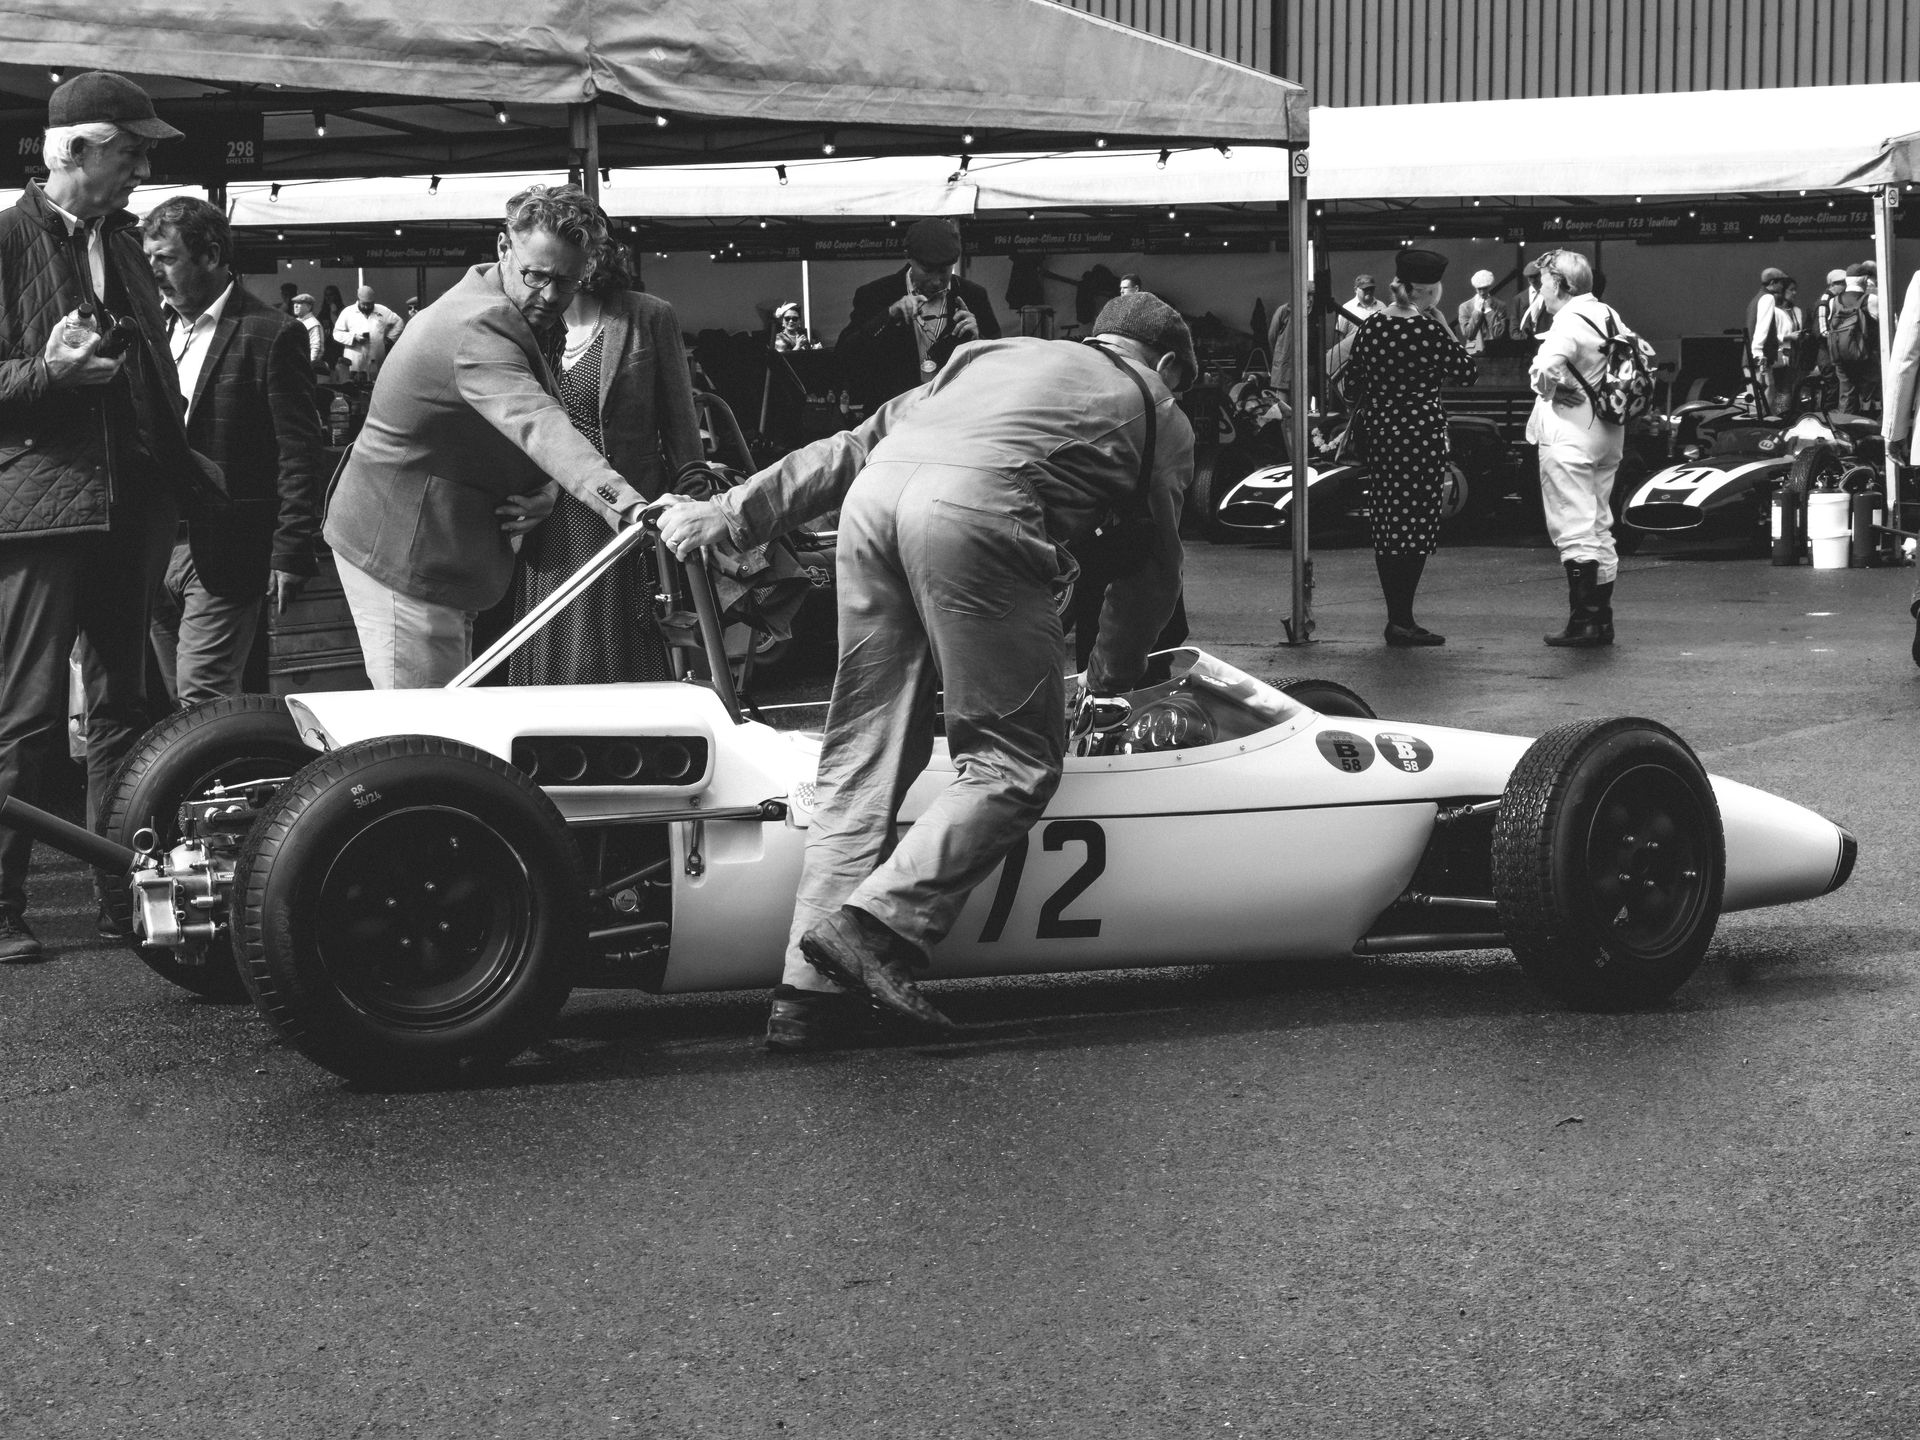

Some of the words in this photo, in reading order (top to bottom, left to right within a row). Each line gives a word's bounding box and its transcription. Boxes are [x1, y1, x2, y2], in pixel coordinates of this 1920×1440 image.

[18, 137, 43, 155] 196
[226, 140, 254, 157] 298
[1565, 218, 1625, 231] Cooper-Climax
[1628, 217, 1644, 228] T53
[1760, 214, 1781, 224] 1960
[1783, 211, 1847, 226] Cooper-Climax
[1850, 211, 1868, 222] T53
[1700, 222, 1717, 231] 283
[833, 239, 883, 251] Cooper-Climax
[1014, 233, 1065, 245] Cooper-Climax
[1333, 743, 1360, 758] B
[1391, 741, 1418, 760] B
[1341, 758, 1362, 771] 58
[1402, 760, 1419, 772] 58
[350, 784, 366, 796] RR
